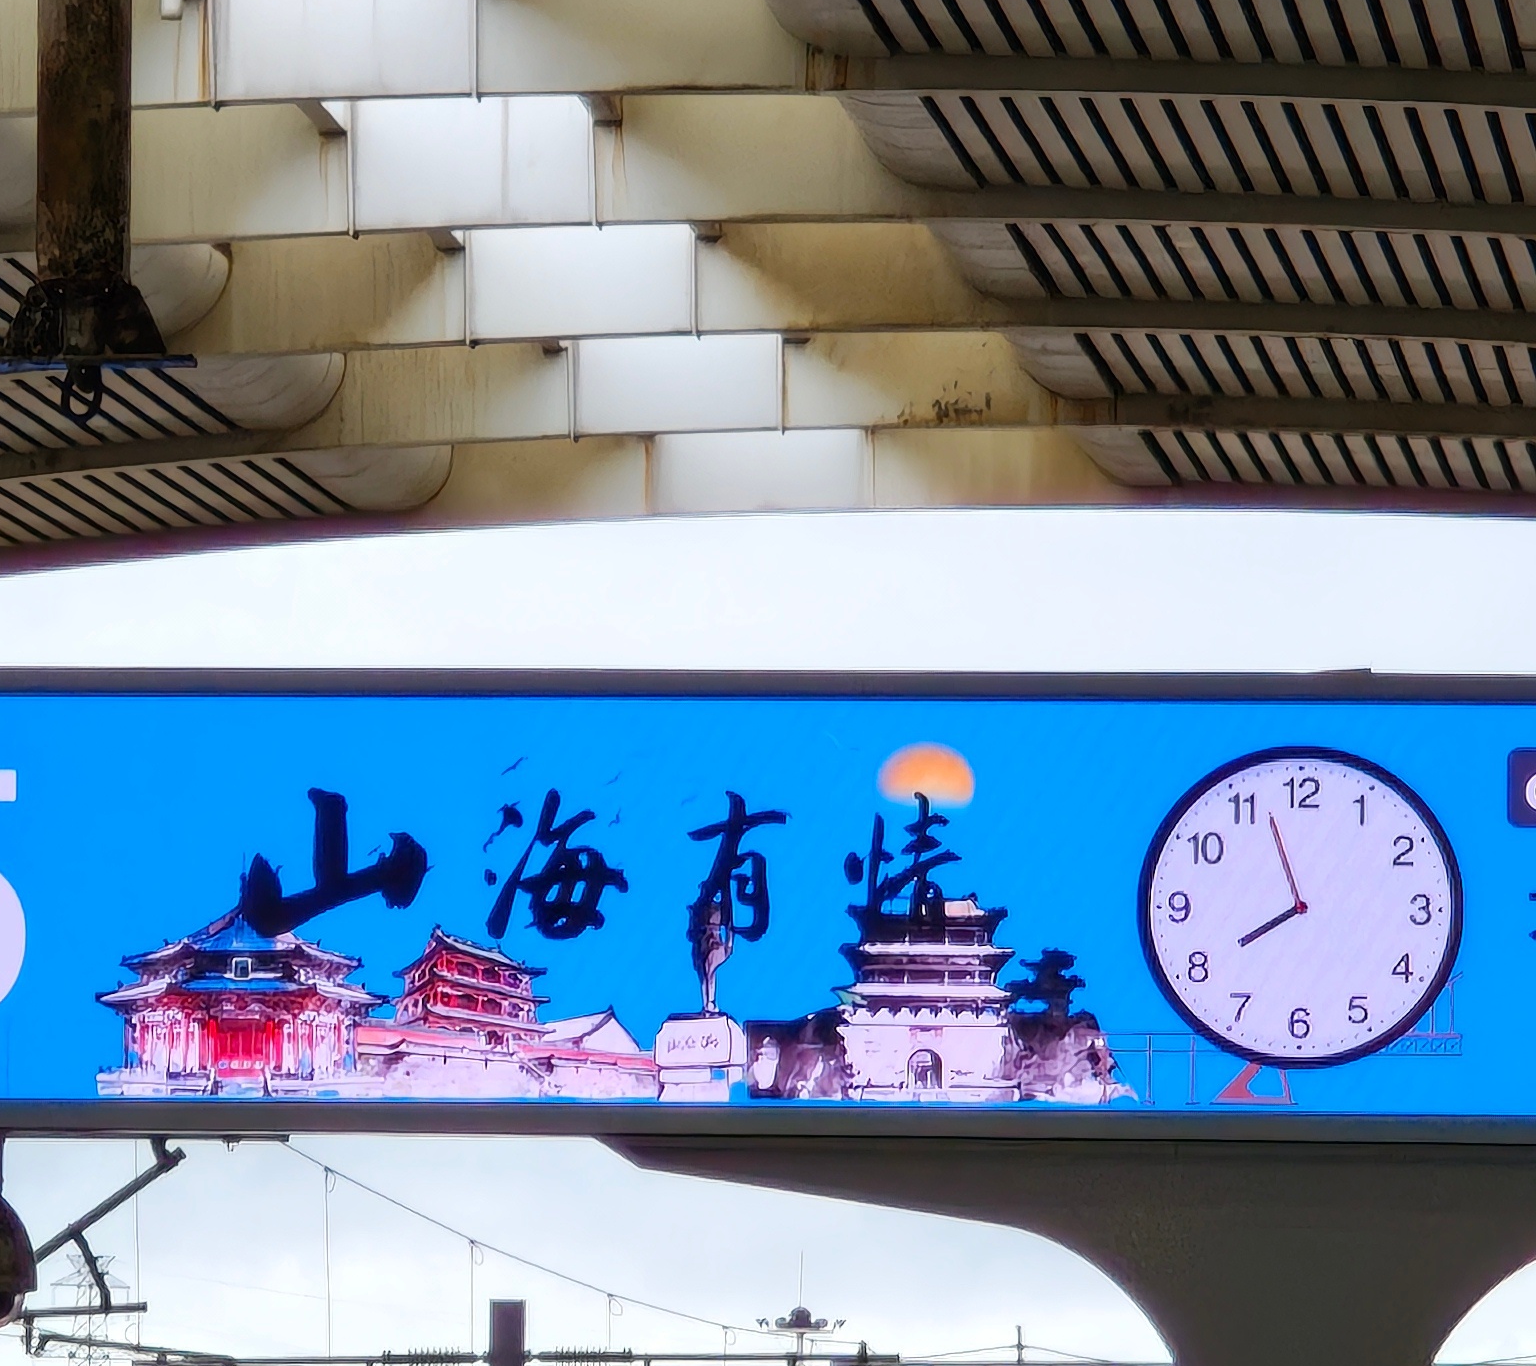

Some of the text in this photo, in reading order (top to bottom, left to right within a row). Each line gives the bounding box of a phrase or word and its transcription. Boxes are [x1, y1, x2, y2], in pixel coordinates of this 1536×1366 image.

[1227, 791, 1256, 825] 11
[1282, 775, 1321, 809] 12
[1352, 794, 1365, 827] 1
[234, 786, 964, 941] 山海有情
[1186, 831, 1224, 865] 10
[1392, 834, 1414, 868] 2
[1168, 890, 1192, 924] 9
[1409, 893, 1433, 926] 3
[1187, 950, 1209, 983] 8
[1390, 952, 1414, 984] 4
[1229, 992, 1252, 1023] 7
[1287, 1007, 1311, 1040] 6
[1347, 995, 1369, 1025] 5
